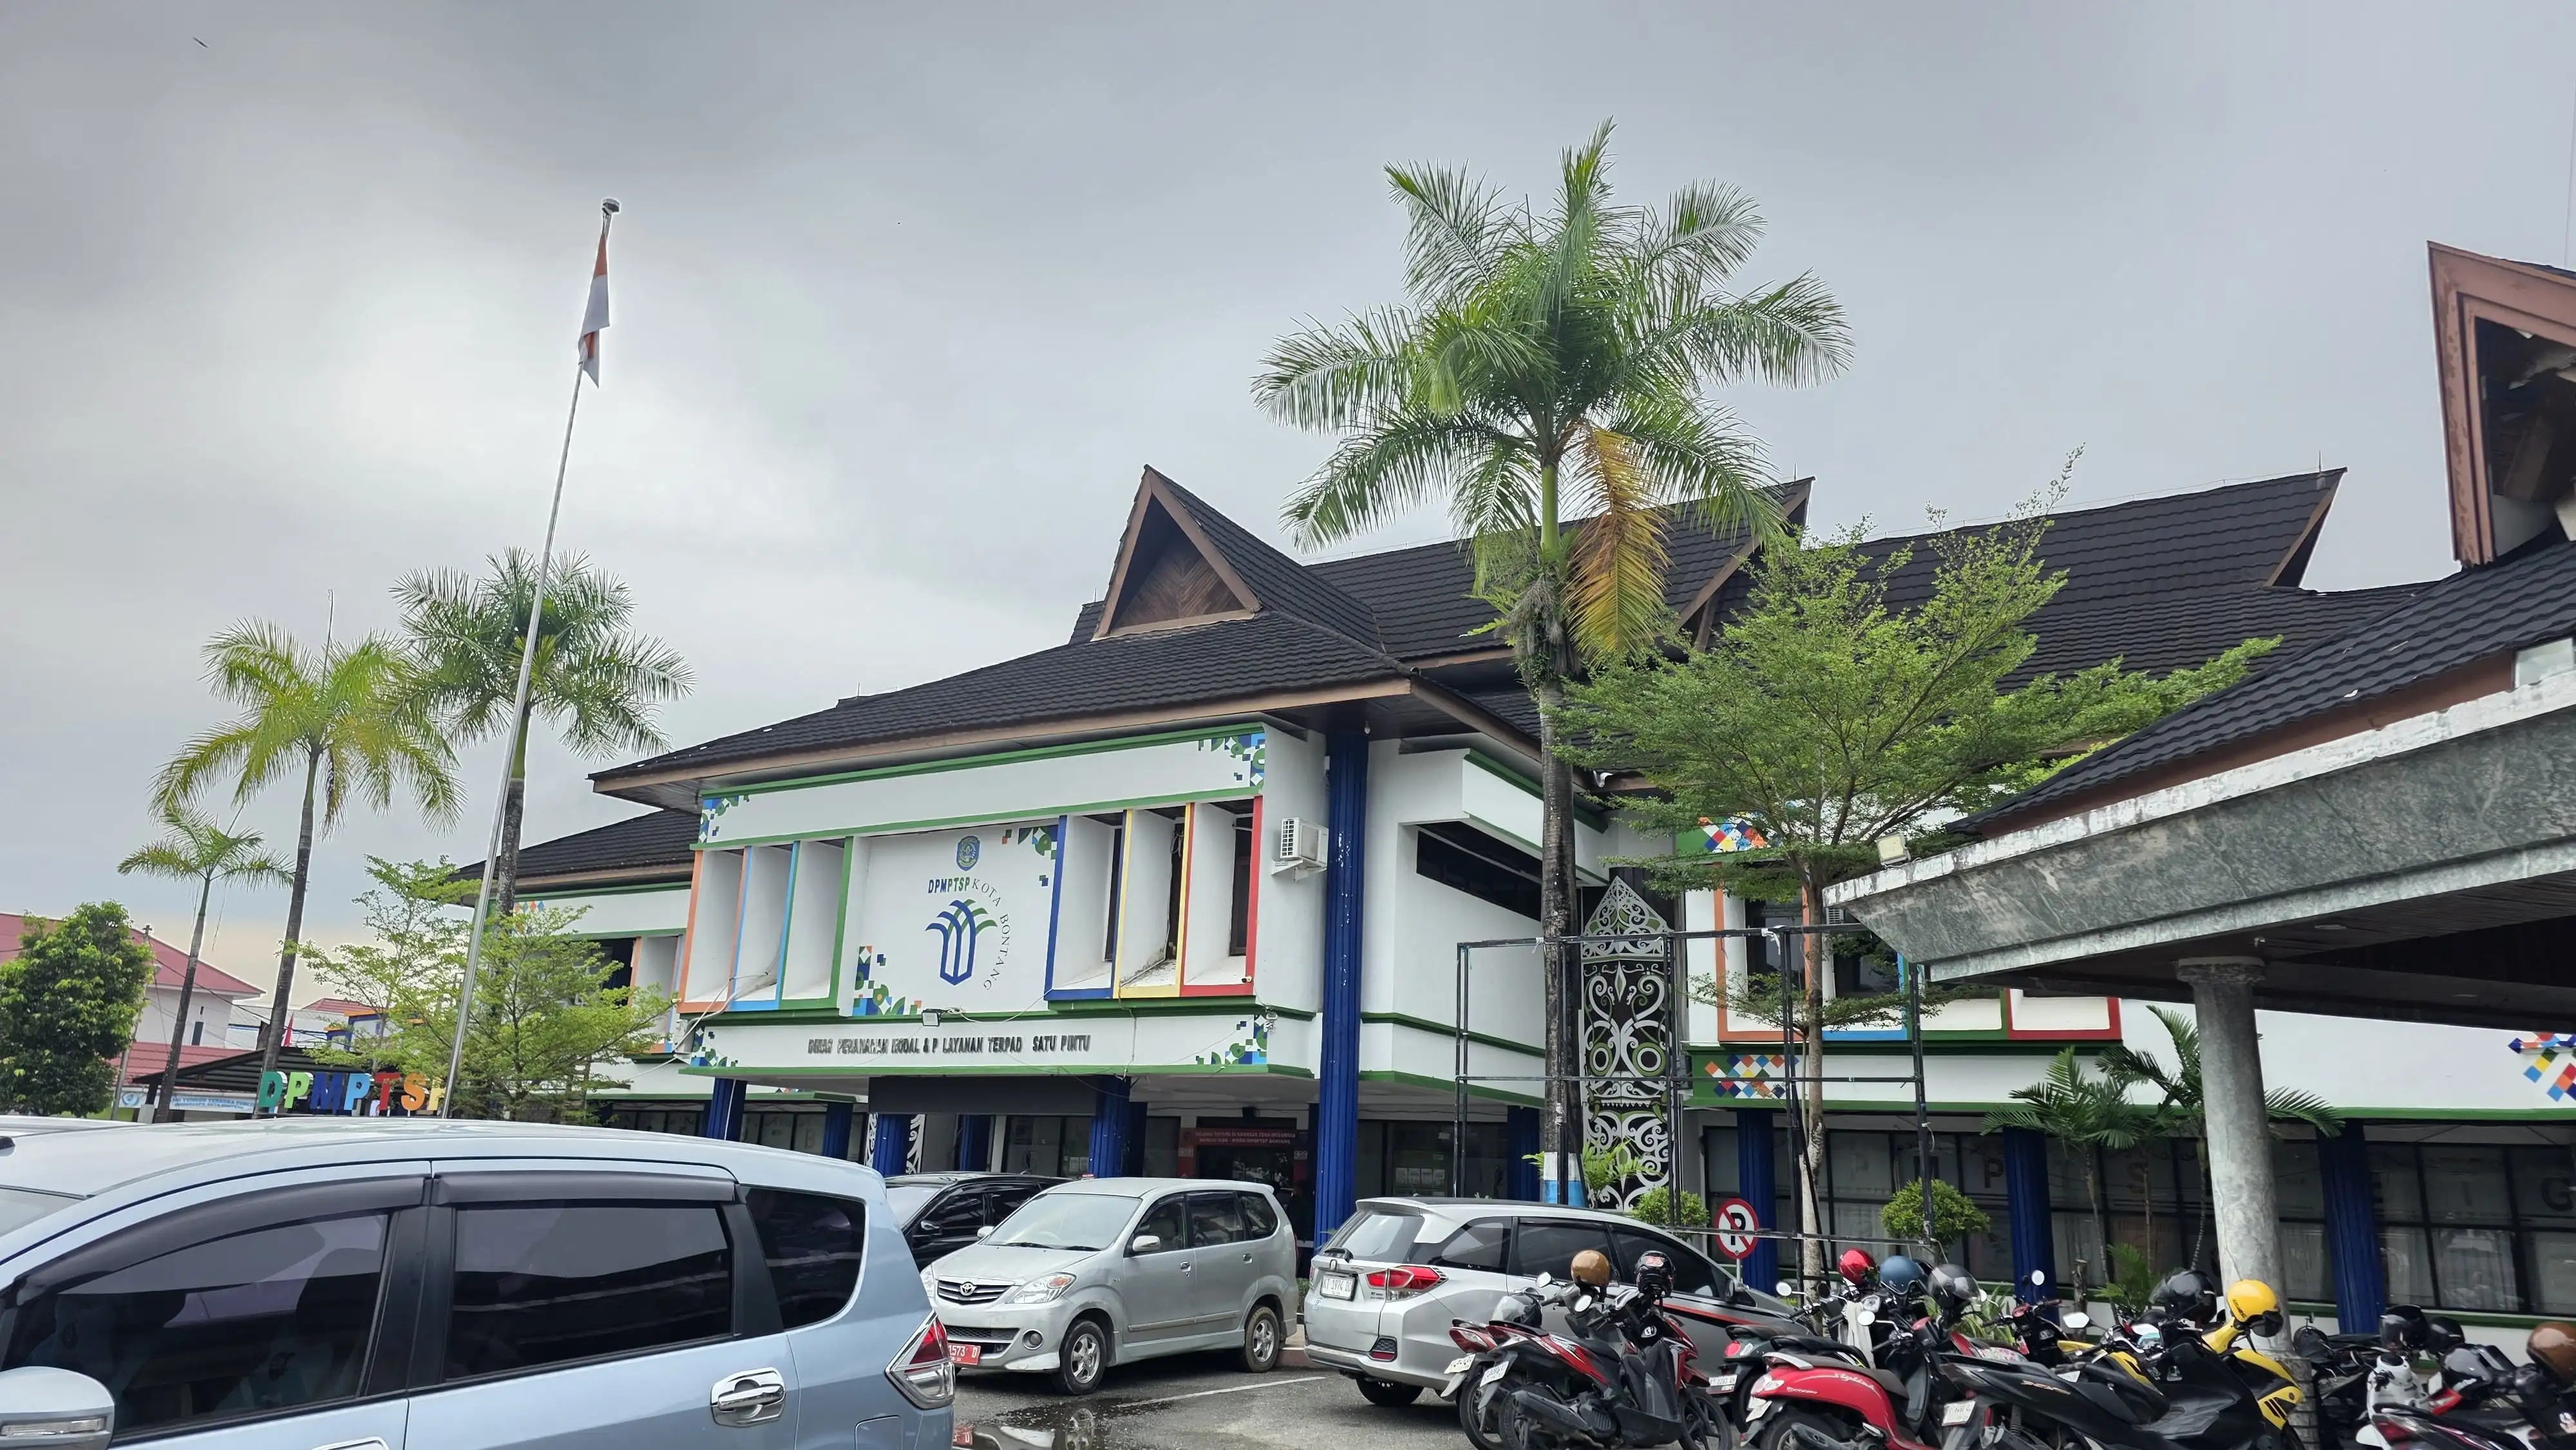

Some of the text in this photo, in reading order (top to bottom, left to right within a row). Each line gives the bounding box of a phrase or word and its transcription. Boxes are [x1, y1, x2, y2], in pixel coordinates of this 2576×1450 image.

[928, 877, 1001, 907] DPMPTSP KOTA
[983, 914, 1010, 991] BONTANG
[1032, 1035, 1057, 1053] SATU
[1060, 1035, 1091, 1052] PINTU
[1730, 1212, 1746, 1245] P
[948, 1344, 966, 1357] 1573
